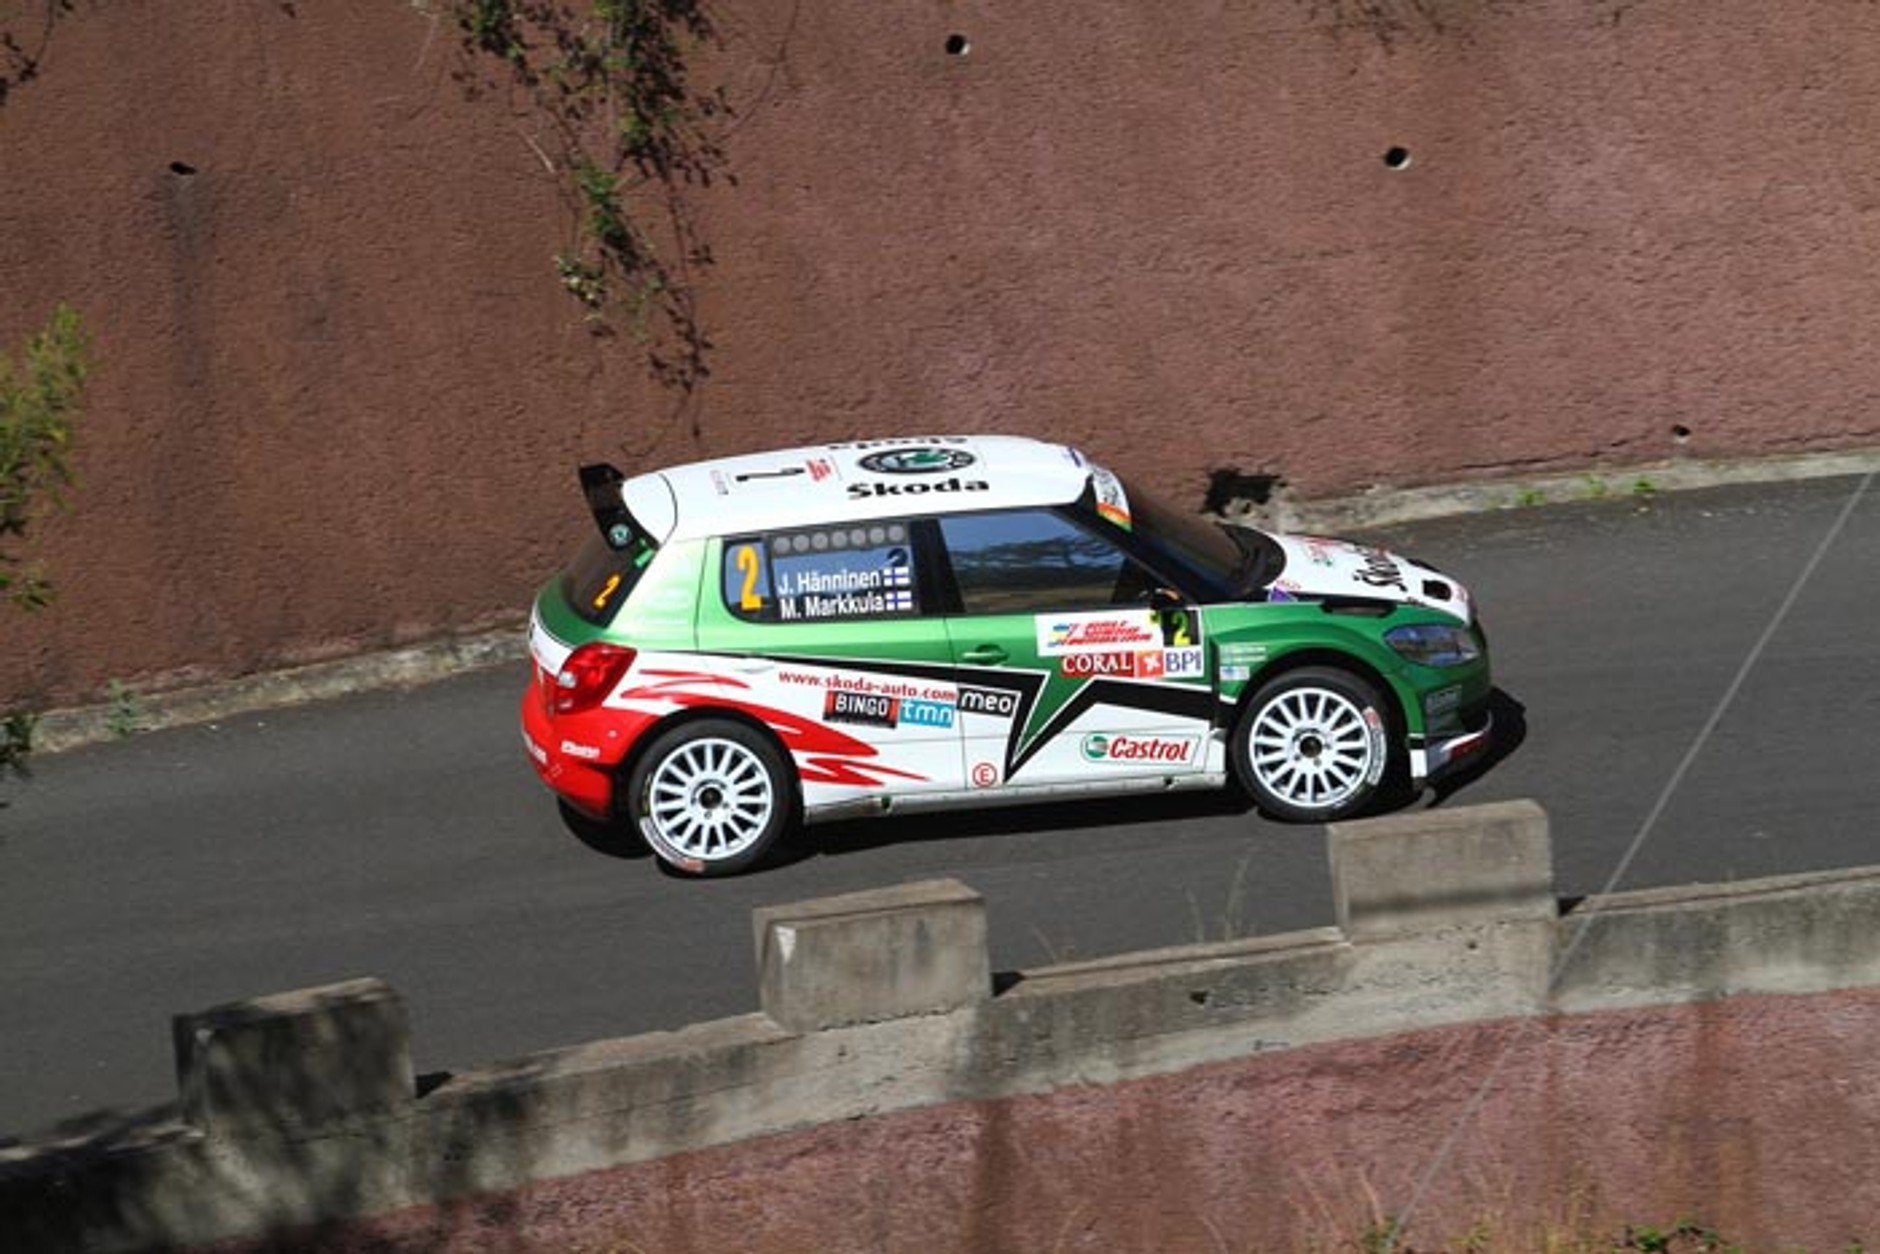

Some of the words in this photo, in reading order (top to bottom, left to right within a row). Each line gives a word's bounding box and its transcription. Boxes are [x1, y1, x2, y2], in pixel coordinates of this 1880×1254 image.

[736, 545, 762, 611] 2
[777, 576, 794, 594] J.
[797, 568, 881, 594] Hänninen
[780, 598, 802, 619] M.
[805, 591, 885, 617] Markkula
[1171, 611, 1192, 647] 2
[1062, 652, 1133, 673] CORAL
[1166, 650, 1203, 673] BPI
[778, 671, 957, 701] www.skoda-auto.com
[835, 693, 890, 717] BINGO
[902, 700, 953, 724] tmn
[962, 691, 1012, 713] meo
[1109, 736, 1190, 761] Castrol
